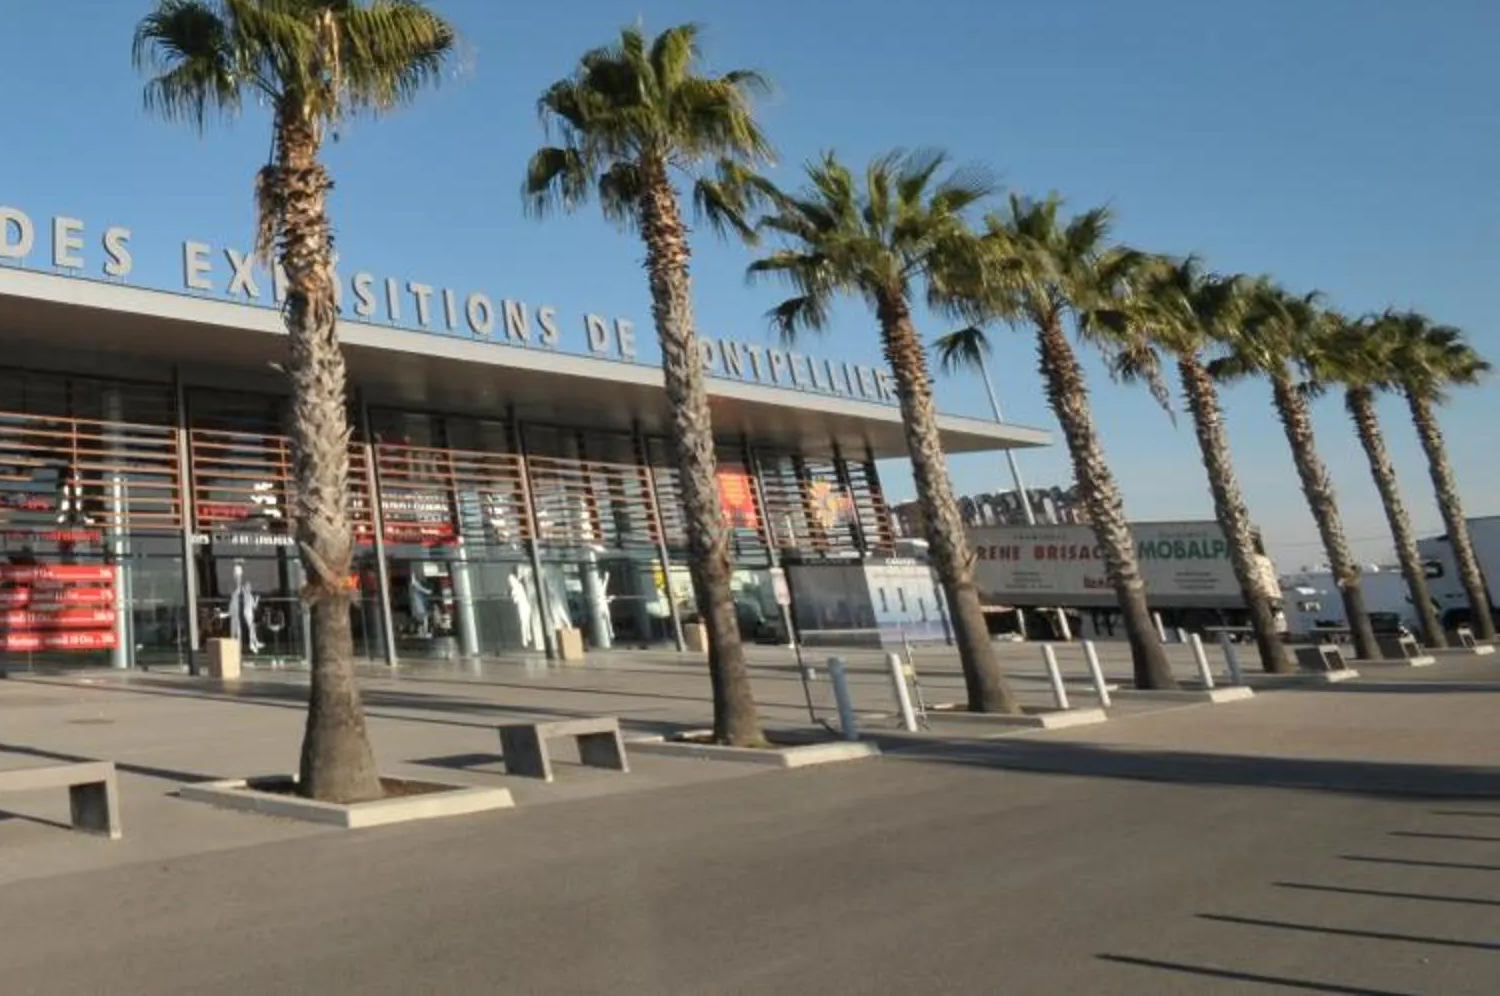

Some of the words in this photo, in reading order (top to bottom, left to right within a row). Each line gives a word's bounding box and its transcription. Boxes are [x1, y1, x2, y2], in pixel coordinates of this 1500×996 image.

[182, 239, 559, 346] EXSITIONS
[583, 313, 637, 358] DE
[696, 335, 899, 401] ONTPELLIER
[1033, 544, 1102, 562] BRISAC
